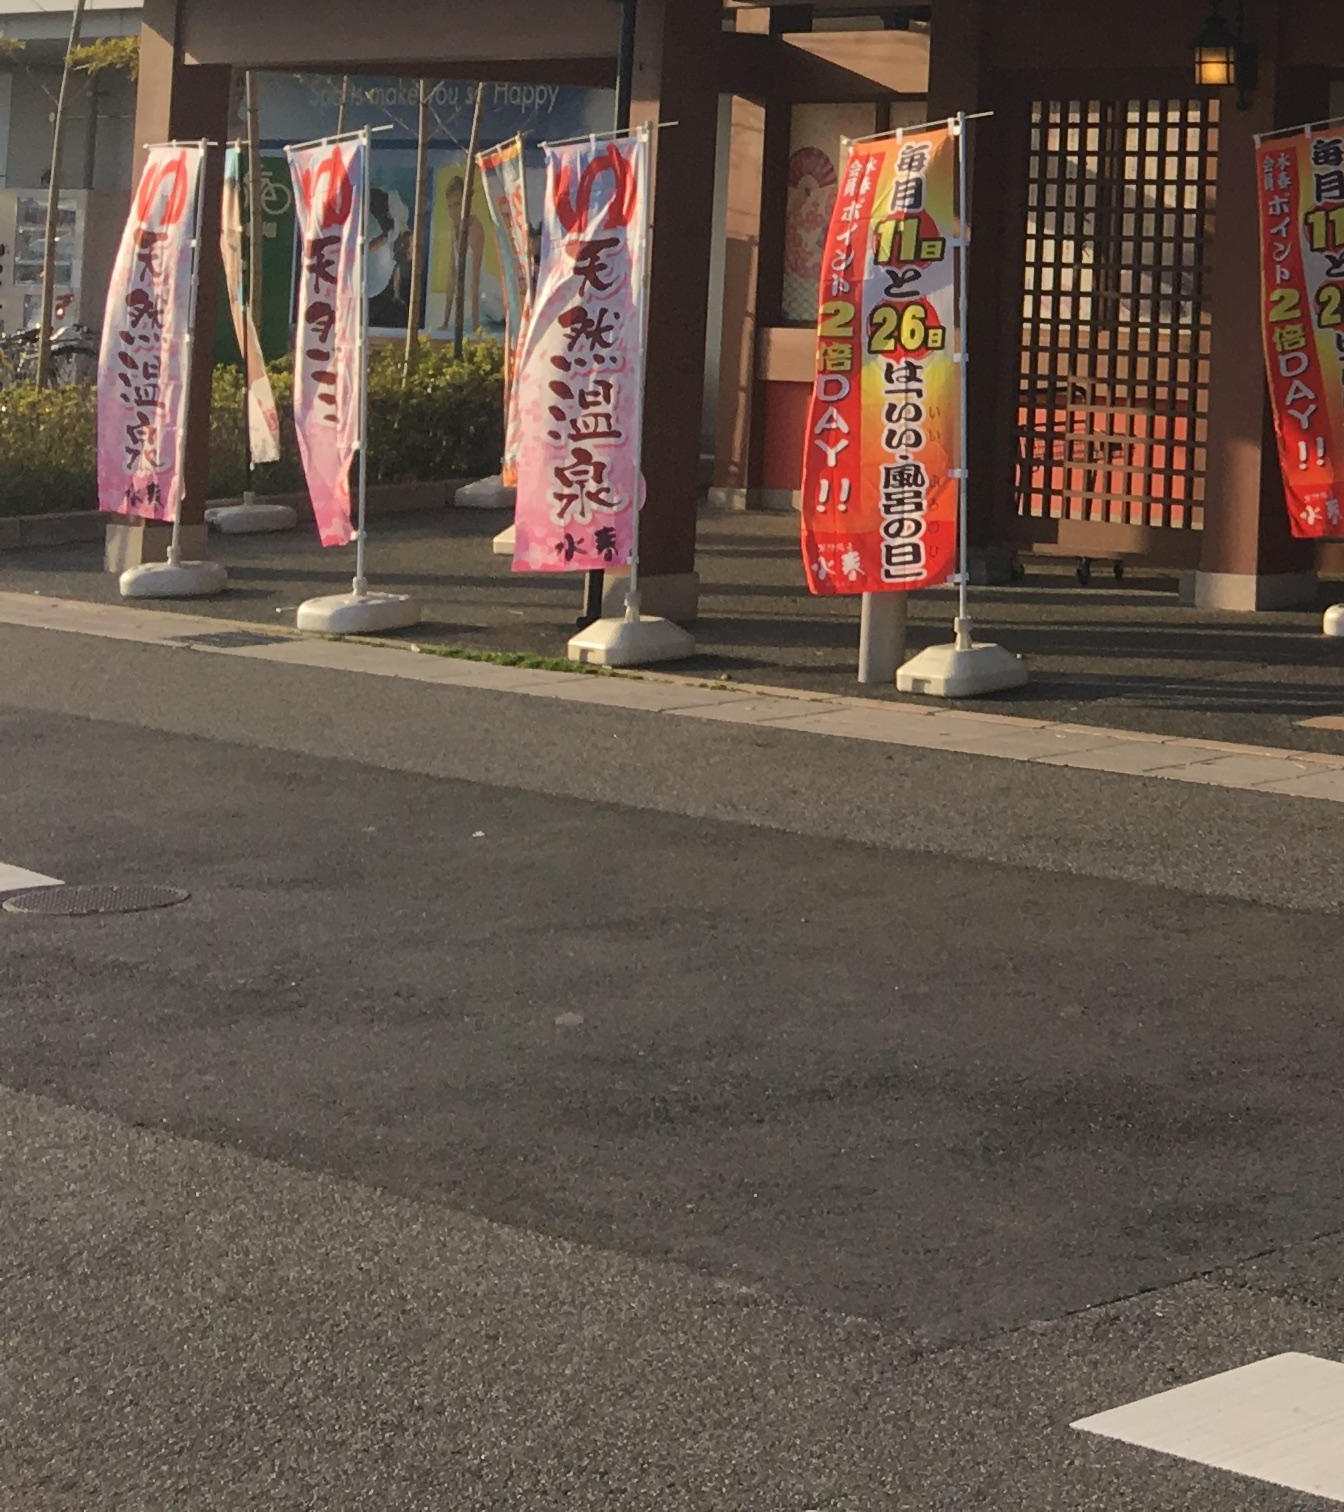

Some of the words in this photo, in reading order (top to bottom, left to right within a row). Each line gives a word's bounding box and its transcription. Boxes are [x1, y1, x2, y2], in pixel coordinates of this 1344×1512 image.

[493, 82, 559, 113] Happy
[554, 142, 637, 234] ゆ
[547, 236, 624, 519] 天然温泉
[555, 525, 619, 563] 水春
